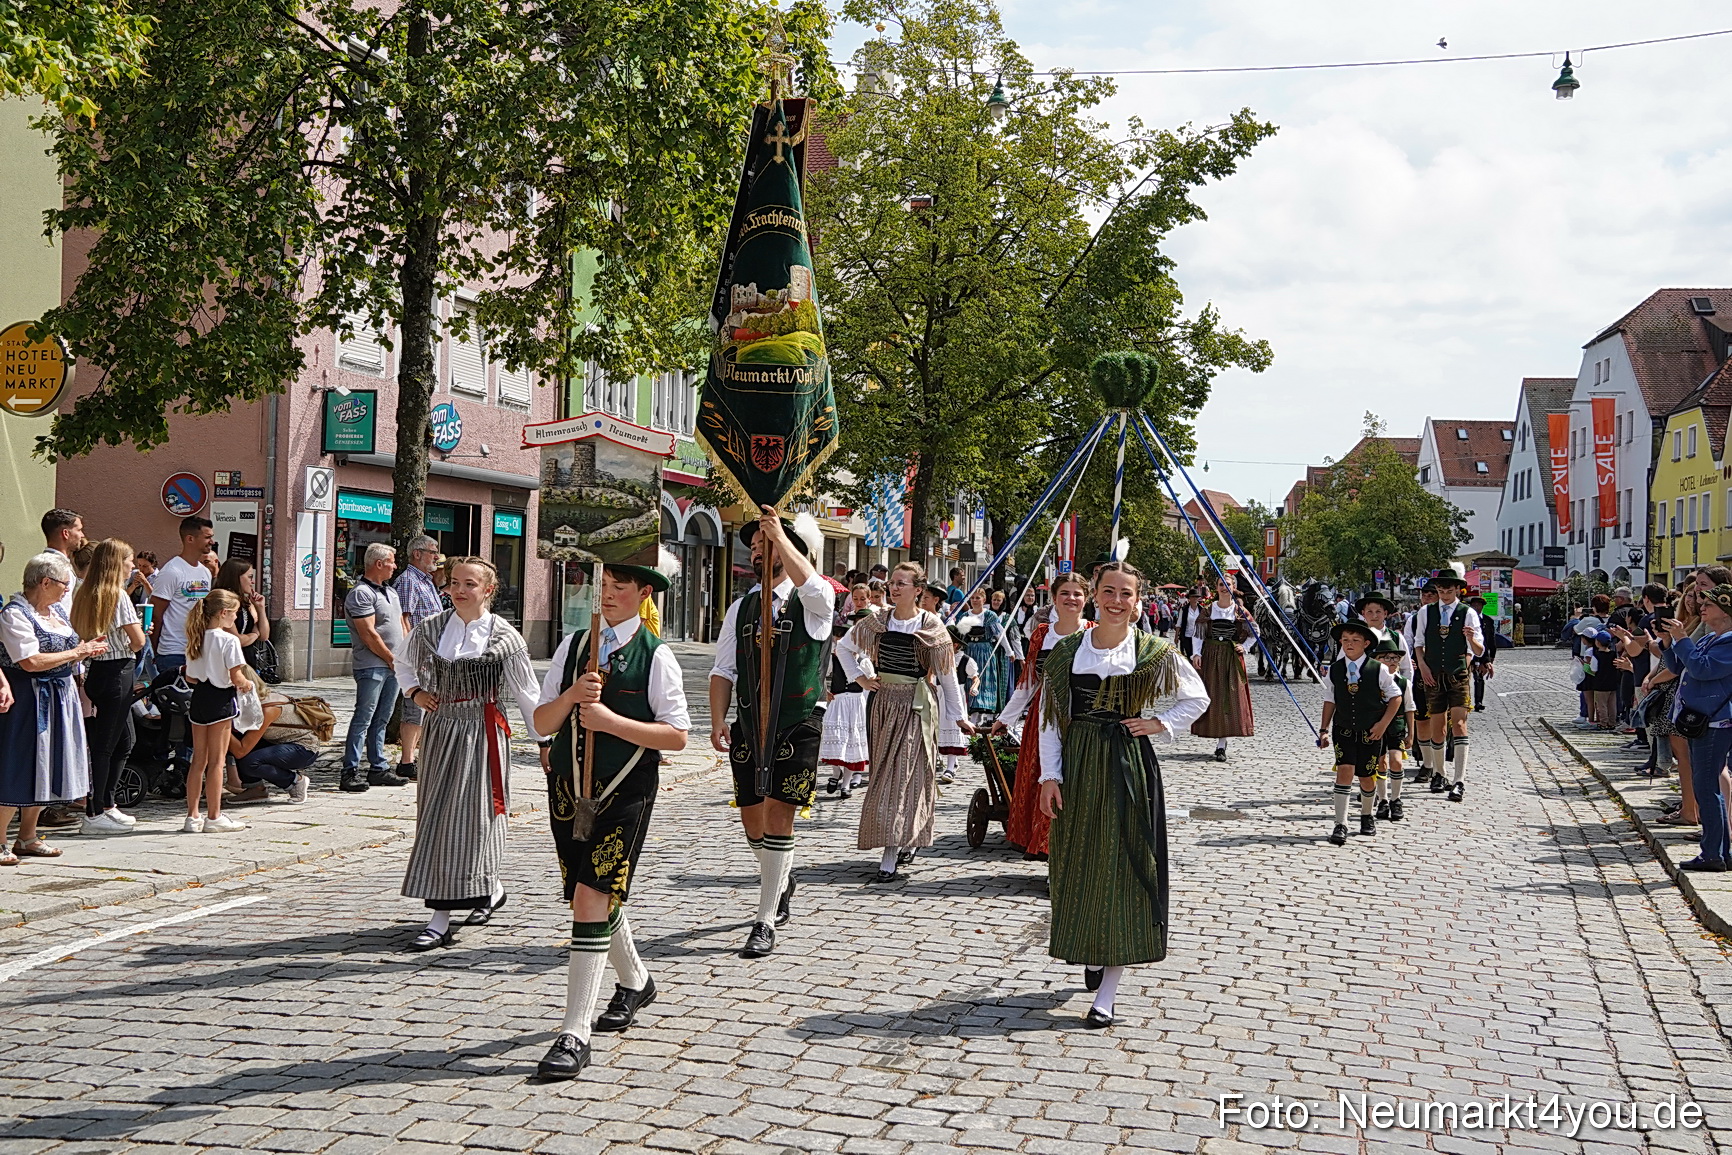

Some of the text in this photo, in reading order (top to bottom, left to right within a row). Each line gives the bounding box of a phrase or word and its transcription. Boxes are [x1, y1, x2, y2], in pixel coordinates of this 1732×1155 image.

[6, 349, 57, 361] HOTEL
[6, 364, 36, 375] NEU
[5, 378, 56, 389] MARKT
[333, 401, 352, 413] vom
[339, 404, 367, 422] FASS
[433, 419, 462, 446] FASS
[535, 421, 649, 444] Almenrausch Neumarkt
[1595, 434, 1615, 486] SALE
[1679, 475, 1697, 492] HOTEL
[216, 487, 262, 498] Bockwirtsgasse
[312, 500, 327, 509] ZONE
[338, 498, 373, 514] Spirituosen
[427, 512, 450, 525] Feinkost
[496, 517, 510, 531] Essig
